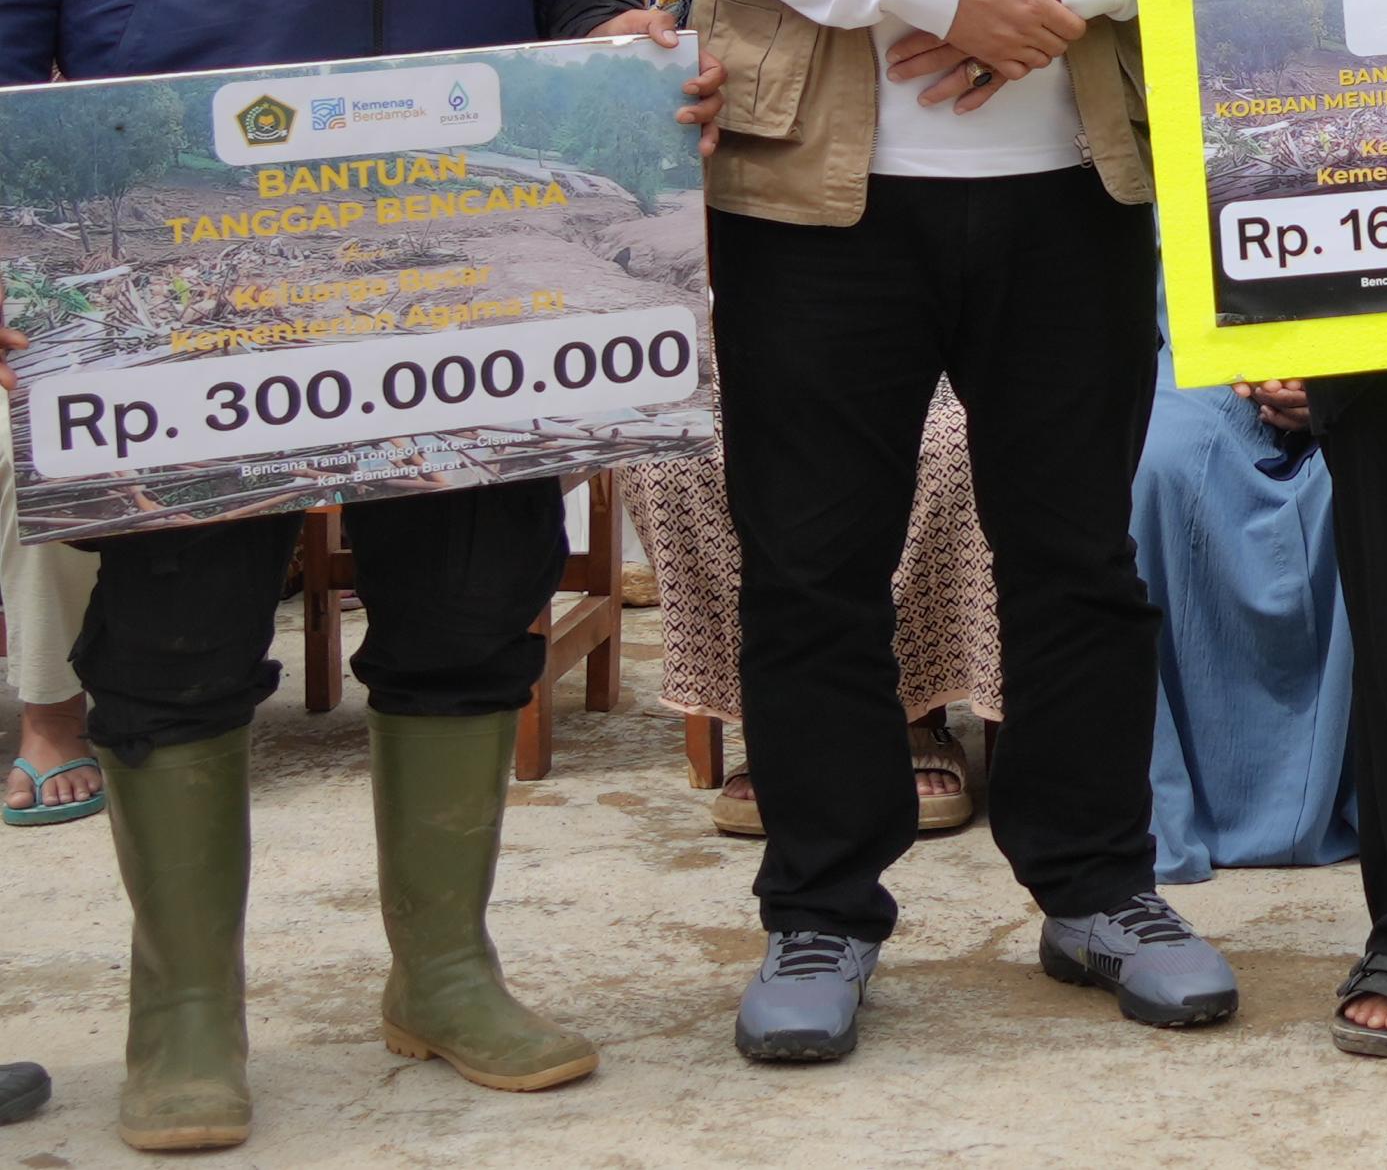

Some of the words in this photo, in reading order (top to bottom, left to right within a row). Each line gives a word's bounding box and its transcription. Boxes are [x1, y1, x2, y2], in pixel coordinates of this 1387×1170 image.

[352, 97, 414, 111] Kemenag
[352, 108, 426, 123] Berdampak
[440, 111, 479, 123] pusaka
[1215, 95, 1318, 118] KORBAN
[258, 152, 467, 199] BANTUAN
[165, 202, 365, 245] TANGGAP
[376, 181, 569, 225] BENCANA
[1237, 217, 1322, 268] Rp.
[233, 270, 389, 312] Keluarga
[400, 262, 494, 294] Besar
[170, 310, 396, 354] Kementerian
[405, 298, 525, 333] Agama
[57, 389, 178, 459] Rp.
[205, 329, 691, 431] 300.000.000
[241, 461, 308, 478] Bencana
[310, 454, 356, 469] Tanah
[360, 446, 420, 464] Longsor
[422, 442, 438, 454] di
[440, 438, 473, 452] Kec.
[476, 432, 532, 448] Cisarua
[317, 474, 350, 487] Kab.
[353, 465, 418, 482] Bandung
[422, 459, 462, 473] Barat
